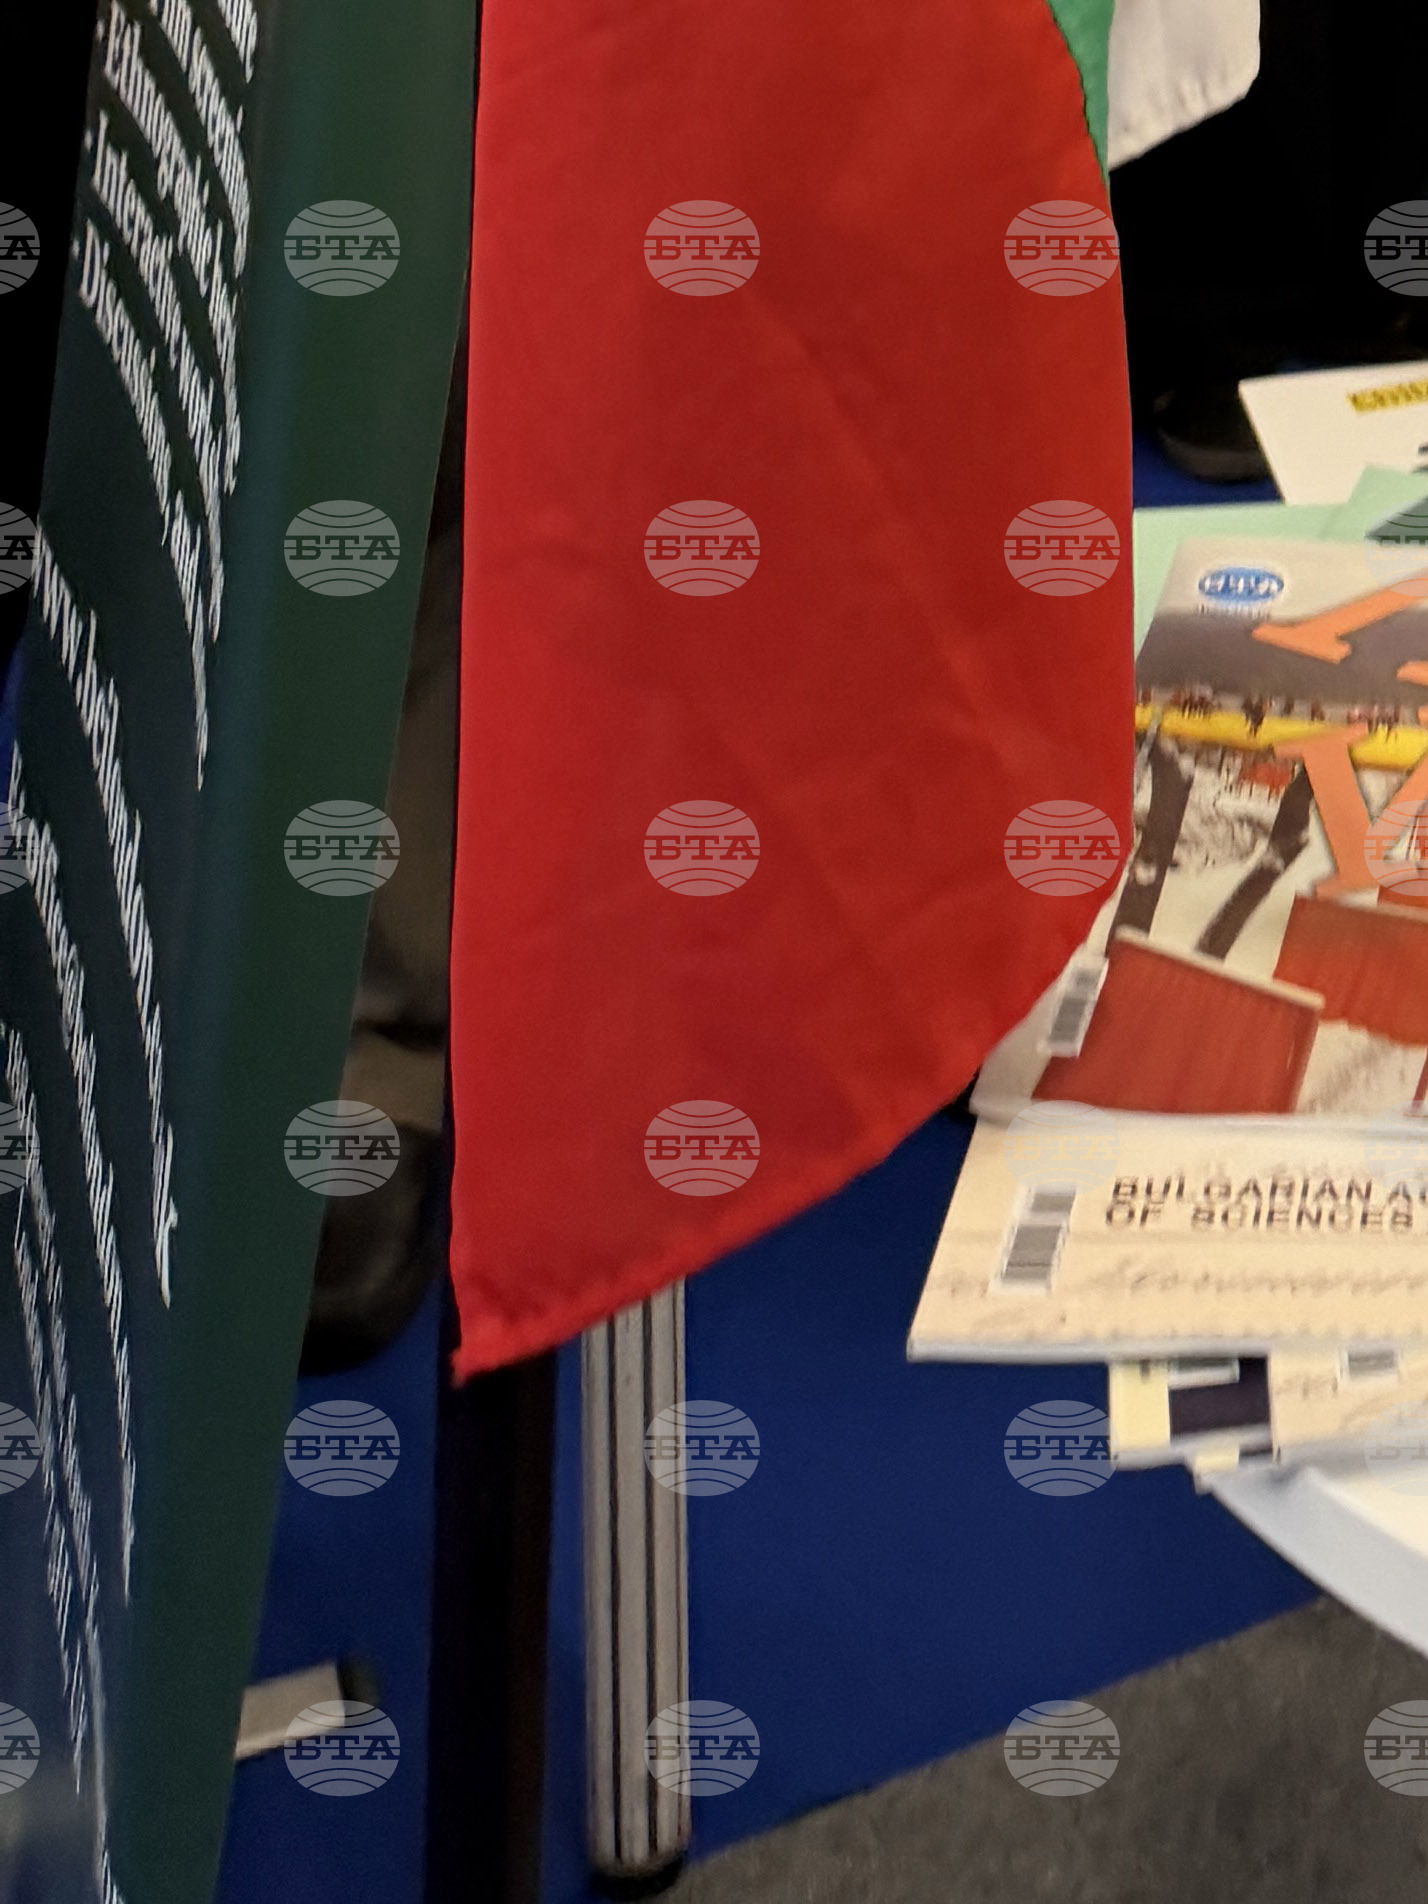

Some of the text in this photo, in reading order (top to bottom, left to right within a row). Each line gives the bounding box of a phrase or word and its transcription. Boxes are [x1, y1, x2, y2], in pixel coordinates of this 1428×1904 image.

[91, 109, 180, 370] Interactive
[1112, 1176, 1375, 1206] BULGARIAN
[1105, 1200, 1164, 1229] OF
[1191, 1204, 1413, 1235] SCIENCES
